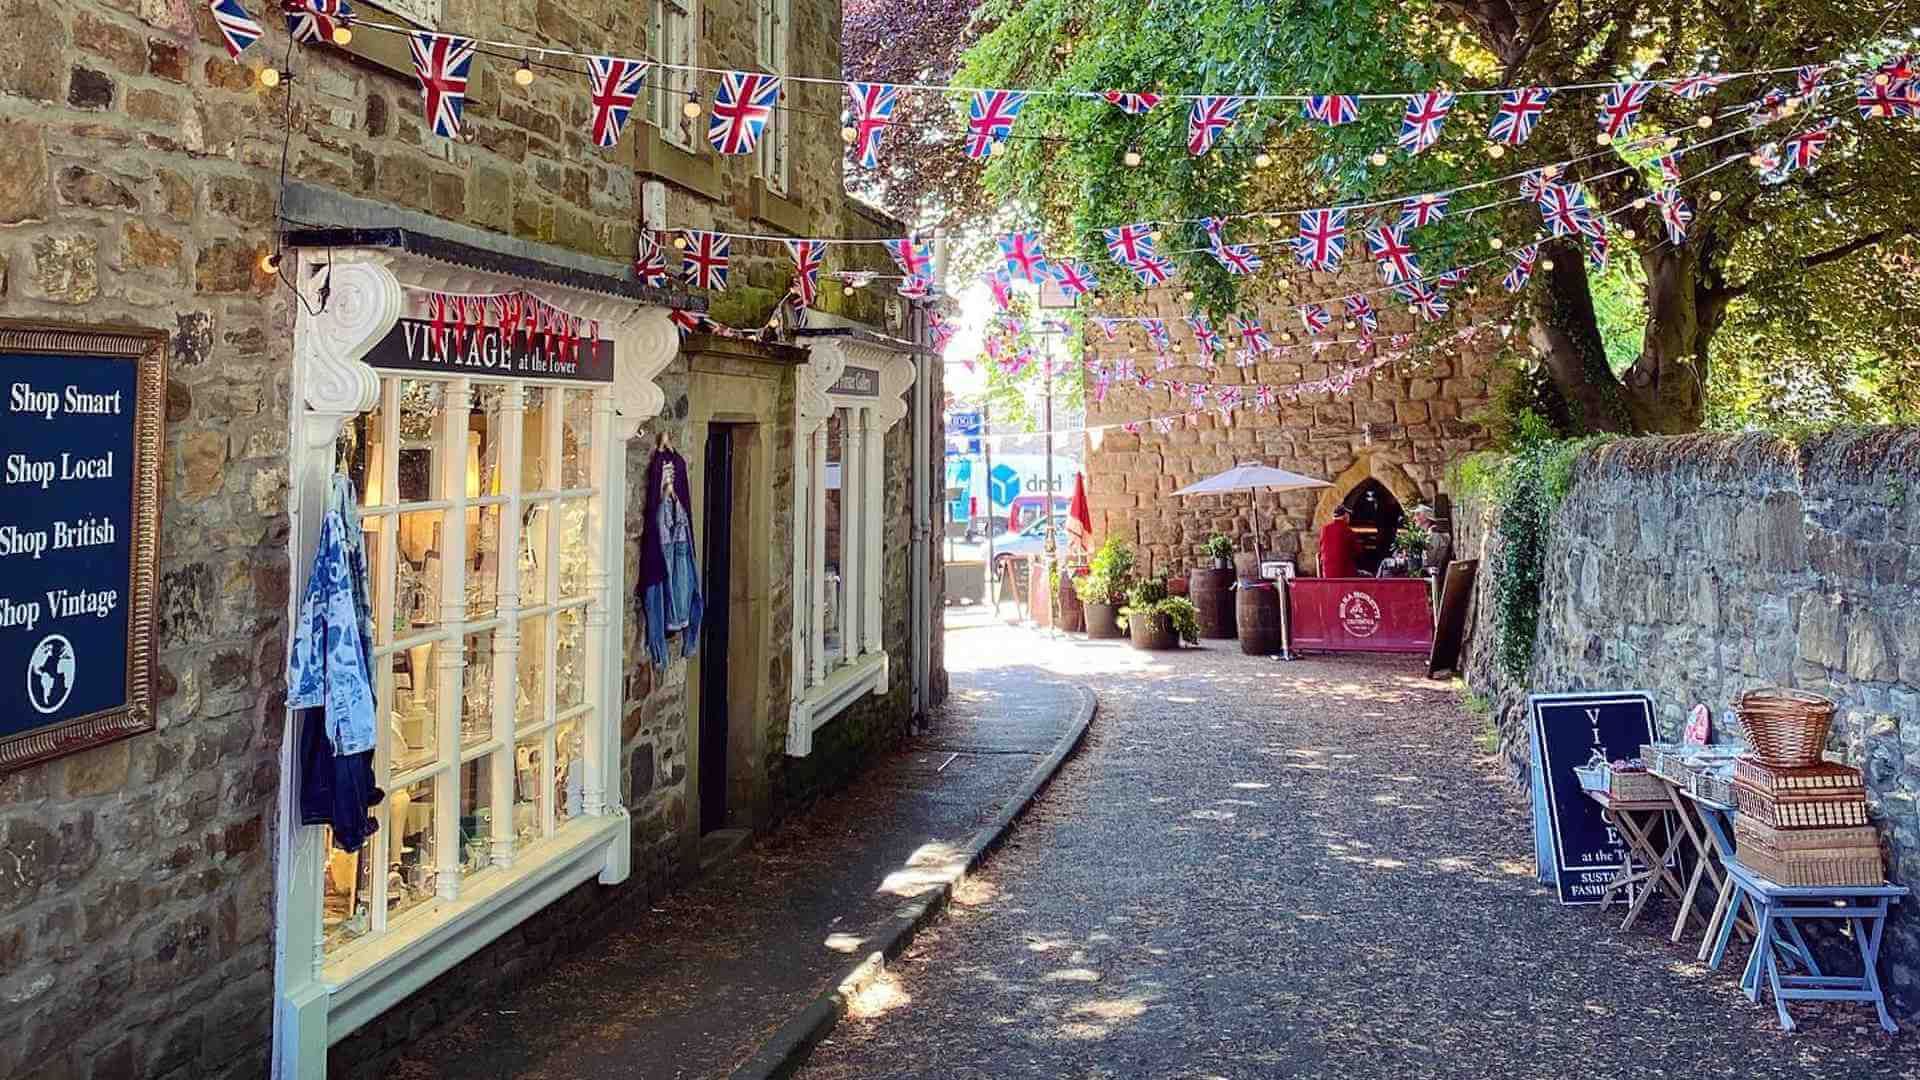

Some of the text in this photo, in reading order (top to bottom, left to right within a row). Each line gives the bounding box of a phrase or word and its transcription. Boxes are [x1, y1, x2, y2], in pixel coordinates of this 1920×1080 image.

[401, 321, 577, 374] VINTAGE at the Tower
[9, 382, 121, 420] Shop Smart
[6, 451, 113, 489] Shop Local
[0, 513, 115, 559] Shop British
[46, 588, 117, 620] Vintage
[1584, 707, 1624, 847] VINE
[1581, 852, 1593, 862] at
[1596, 849, 1614, 862] the
[1571, 885, 1622, 896] FASHI
